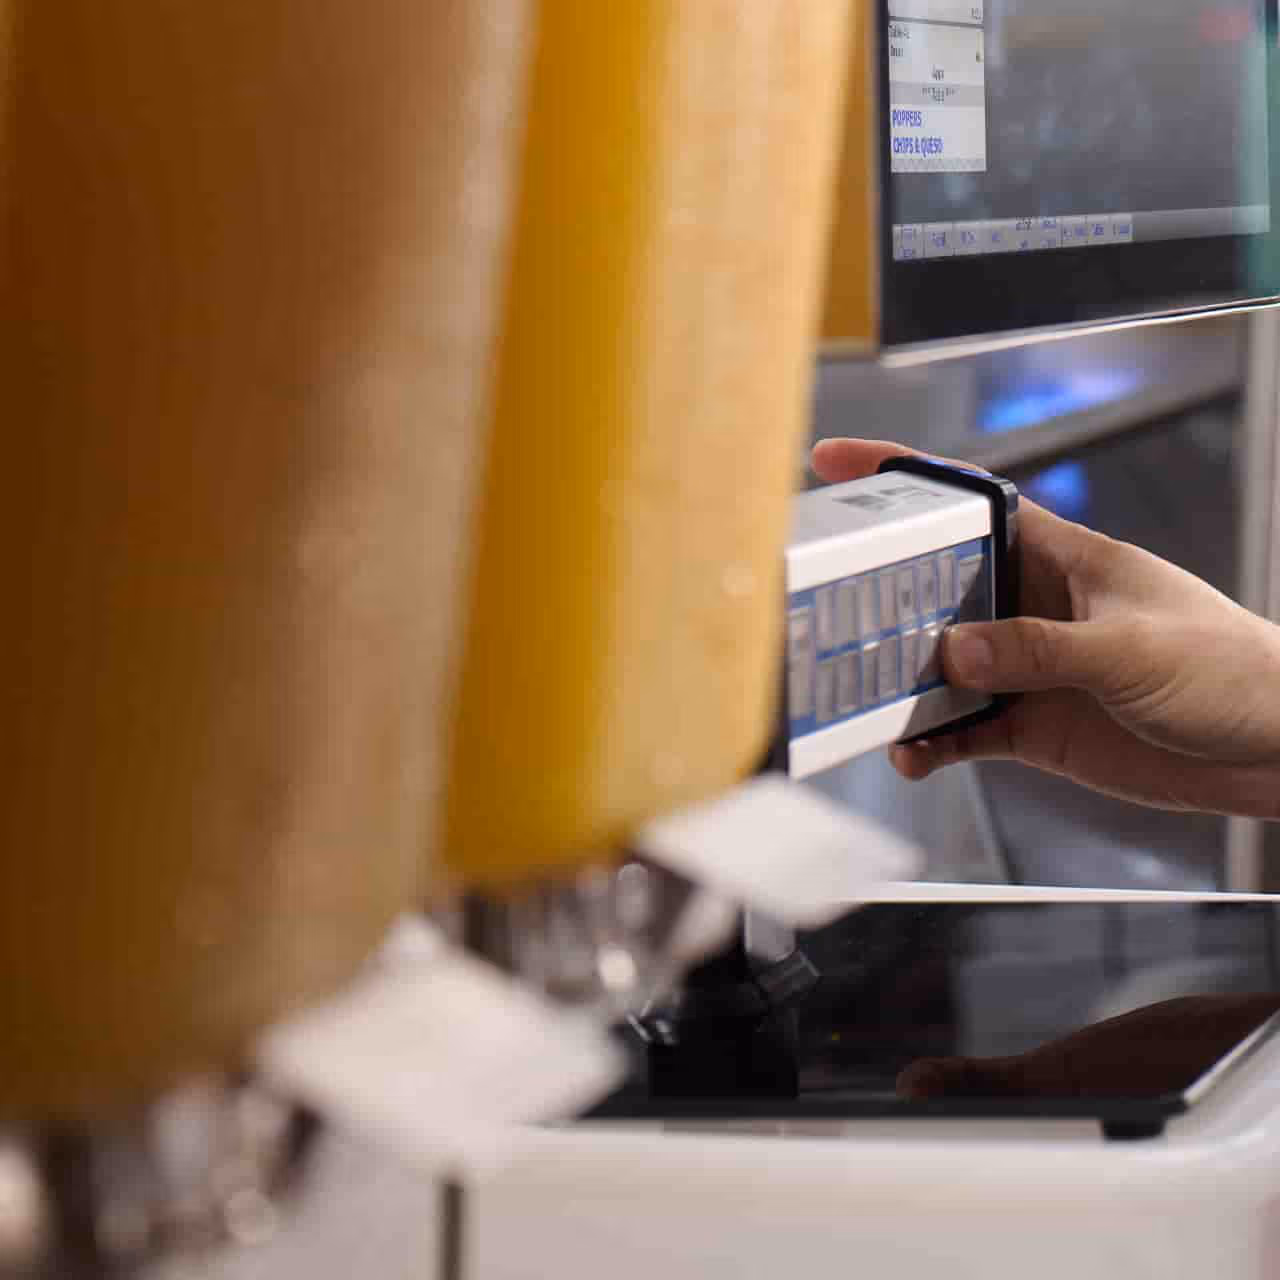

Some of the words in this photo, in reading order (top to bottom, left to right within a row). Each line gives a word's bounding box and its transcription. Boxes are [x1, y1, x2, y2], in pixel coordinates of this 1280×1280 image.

[892, 110, 922, 128] POPPERS
[893, 136, 914, 154] CHIPS
[921, 138, 944, 158] QUESO
